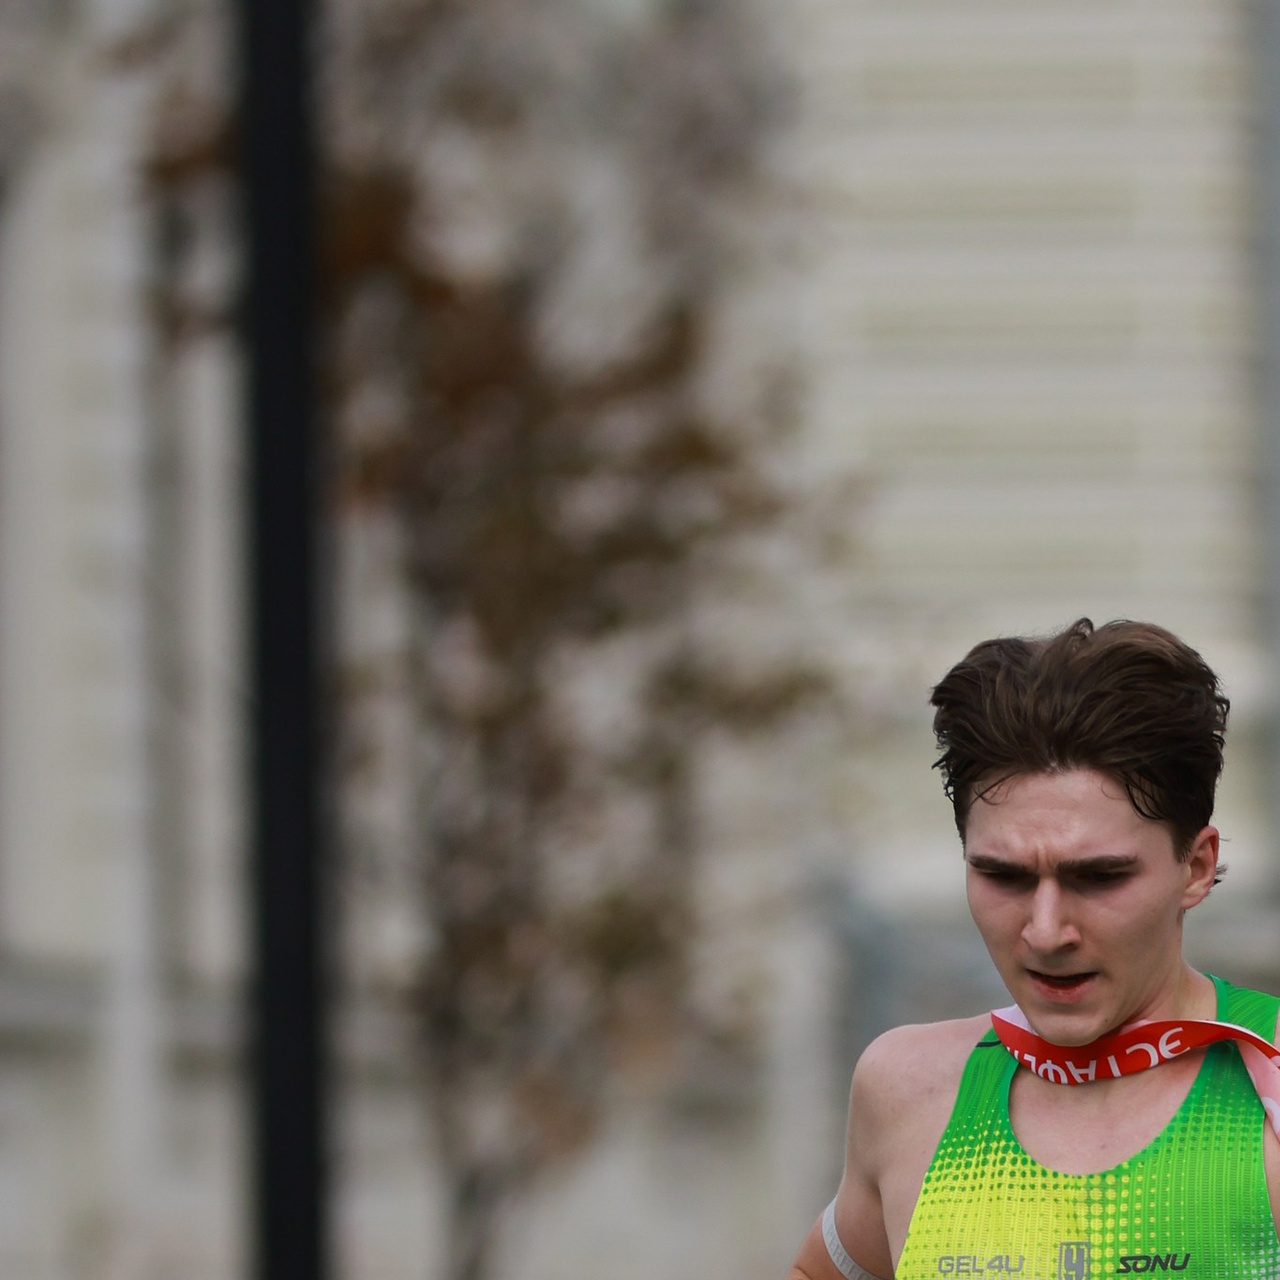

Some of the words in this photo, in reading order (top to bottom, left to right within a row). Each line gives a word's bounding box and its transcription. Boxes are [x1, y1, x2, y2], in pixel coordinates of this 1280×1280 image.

[1006, 1027, 1191, 1086] ЭСТАФ
[938, 1255, 1025, 1274] GEL4U
[1116, 1253, 1191, 1274] SONU
